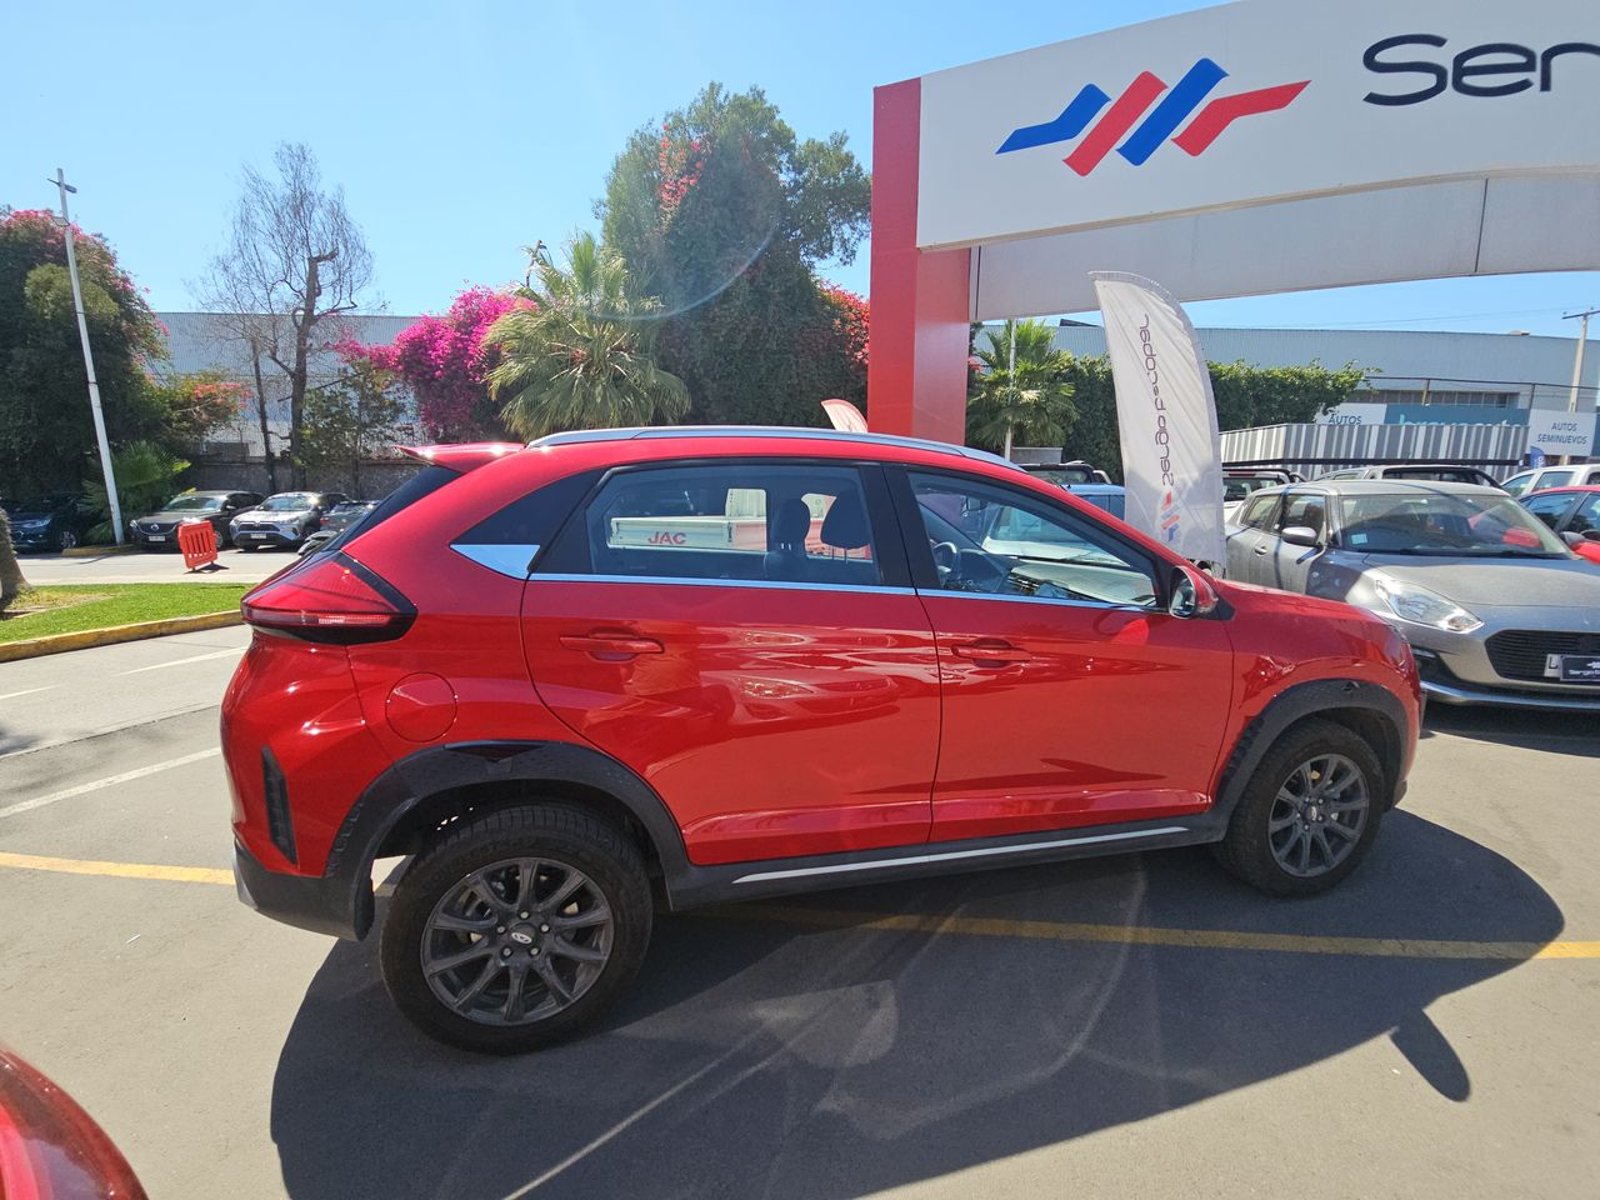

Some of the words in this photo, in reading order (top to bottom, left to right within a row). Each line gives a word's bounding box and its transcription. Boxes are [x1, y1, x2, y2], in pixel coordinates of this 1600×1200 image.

[1363, 34, 1600, 106] Ser
[1328, 415, 1362, 425] AUTOS
[1551, 422, 1578, 432] AUTOS
[1537, 433, 1588, 445] SEMINUEVOS
[648, 531, 687, 545] JAC
